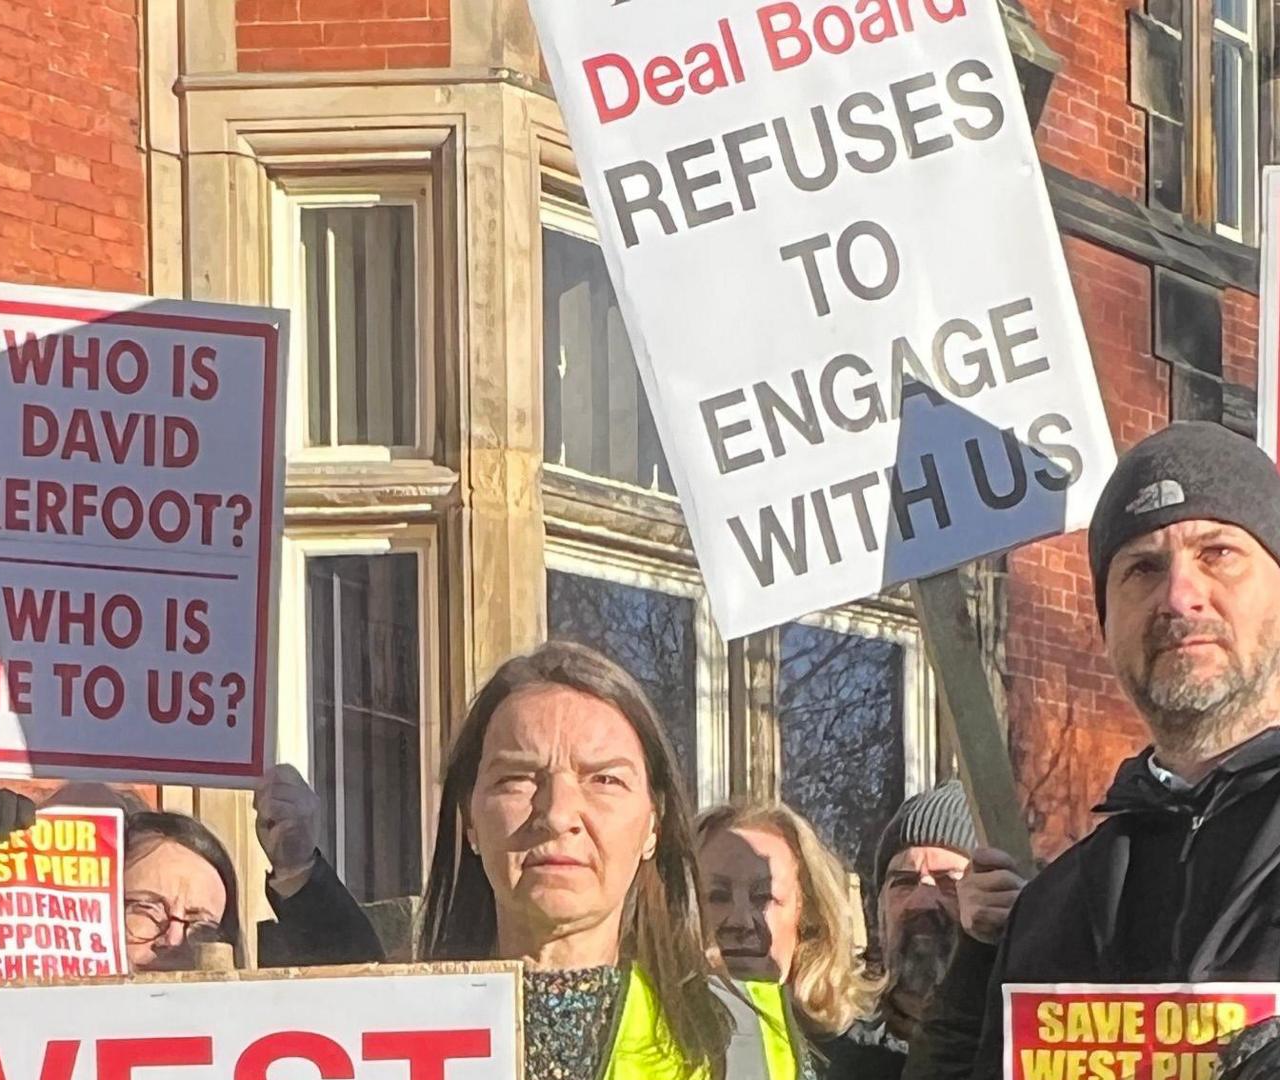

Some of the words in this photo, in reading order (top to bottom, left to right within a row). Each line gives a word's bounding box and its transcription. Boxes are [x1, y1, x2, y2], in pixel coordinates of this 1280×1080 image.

[583, 18, 745, 125] Deal
[603, 59, 1004, 249] REFUSES
[780, 220, 900, 317] TO
[4, 329, 149, 394] WHO
[172, 344, 218, 400] IS
[699, 297, 1050, 475] ENGAGE
[23, 404, 200, 468] DAVID
[727, 454, 952, 587] WITH
[965, 413, 1085, 509] US
[2, 586, 143, 649] WHO
[165, 598, 210, 655] IS
[53, 663, 125, 720] TO
[147, 670, 246, 728] US?
[32, 819, 96, 852] OUR
[33, 855, 110, 887] PIER!
[91, 933, 107, 953] &
[1037, 1001, 1144, 1044] SAVE
[1155, 1002, 1246, 1045] OUR
